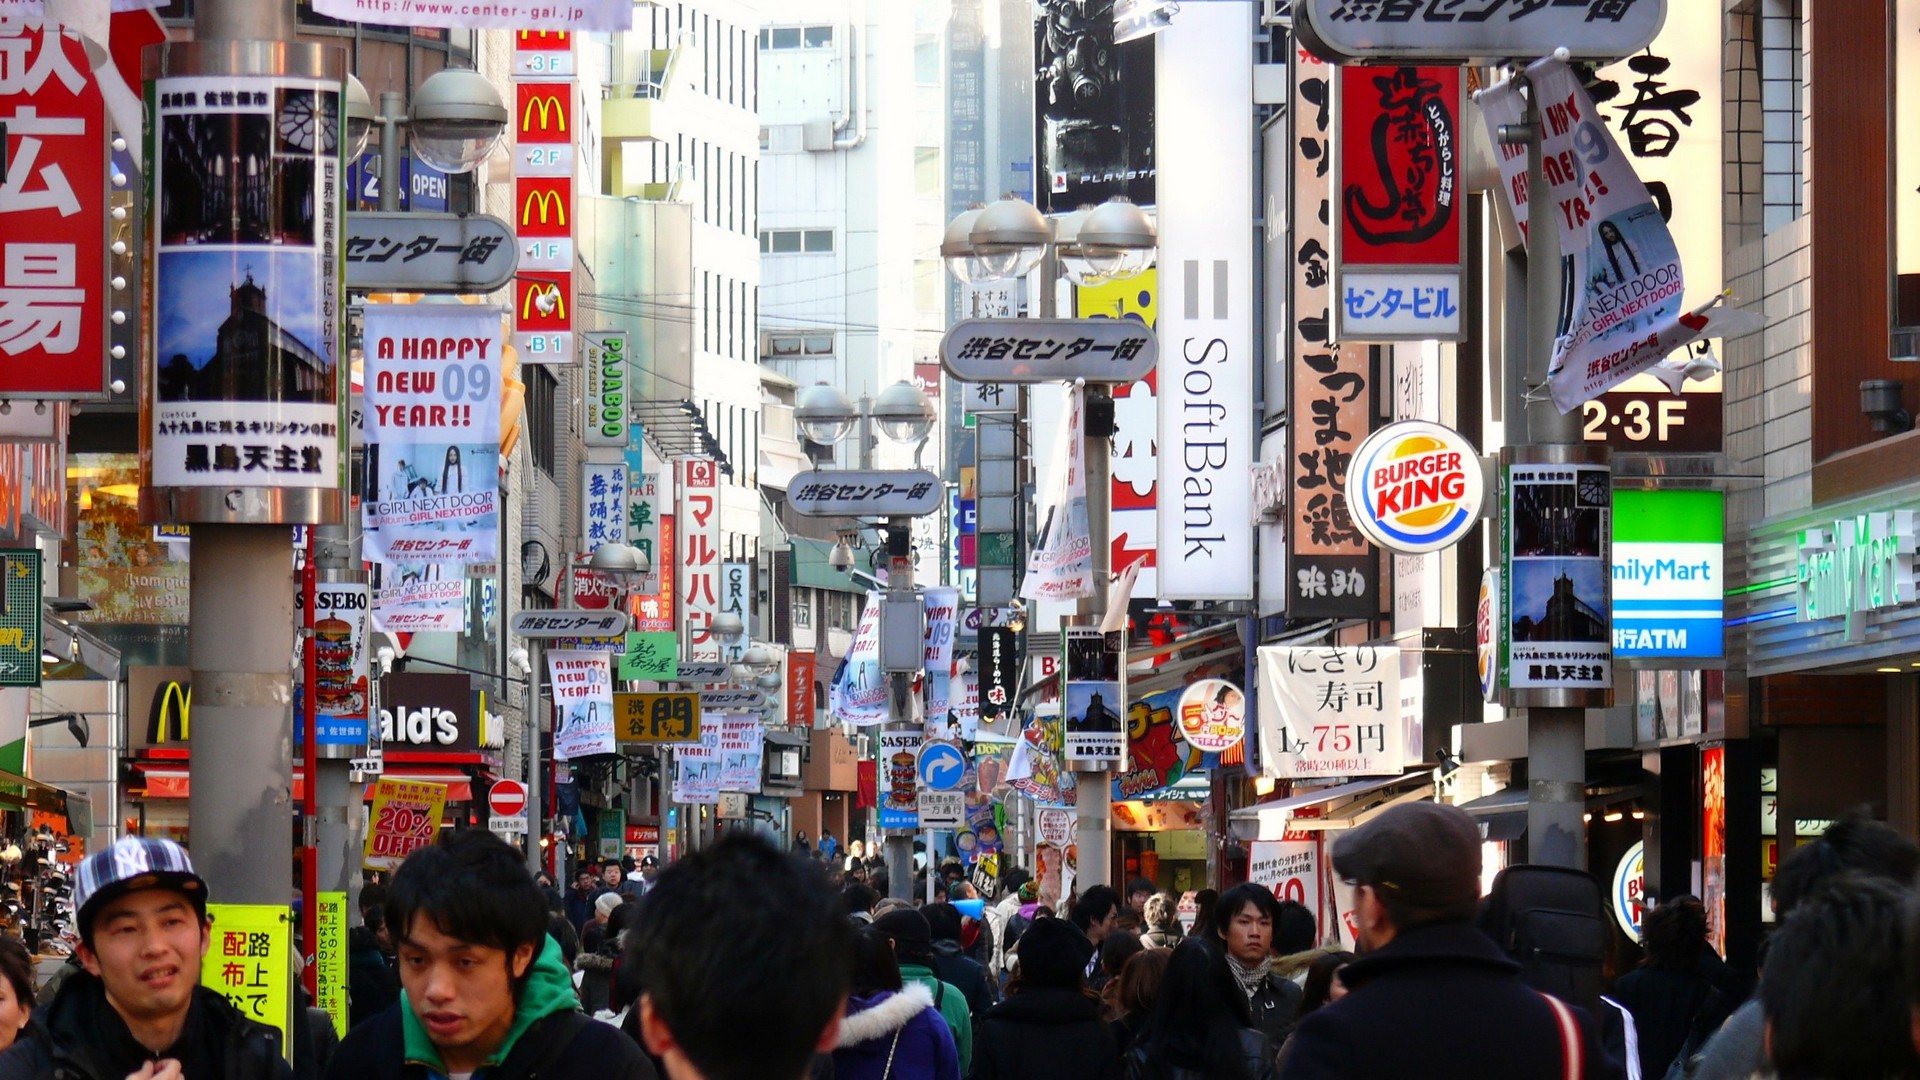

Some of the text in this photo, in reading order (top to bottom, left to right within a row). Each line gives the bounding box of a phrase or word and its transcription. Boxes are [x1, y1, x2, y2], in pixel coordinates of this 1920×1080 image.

[1427, 104, 1453, 208] とうがらし料理
[413, 174, 446, 199] OPEN
[1344, 287, 1457, 319] センタービル
[1588, 262, 1681, 319] NEXT DOOR
[1592, 280, 1682, 333] GIRL NEXT DOOR
[377, 337, 492, 360] A HAPPY
[957, 336, 1148, 361] 渋谷センター街
[376, 363, 492, 403] NEW 09
[601, 337, 623, 439] PAJABOO
[374, 404, 472, 428] YEAR!!
[184, 444, 323, 474] 黒島天主堂
[1184, 337, 1229, 561] SoftBank
[1373, 452, 1463, 491] BURGER
[378, 490, 493, 516] GIRL NEXT DOOR
[796, 481, 933, 502] 渋谷センター街
[1376, 471, 1466, 520] KING
[409, 511, 434, 523] GIRL
[435, 507, 463, 520] NEXT
[464, 503, 494, 516] DOOR
[588, 472, 609, 554] 舞踊教
[389, 538, 473, 552] 渋谷センター街
[430, 580, 462, 593] DOOR
[295, 592, 367, 610] SSEBO
[518, 615, 616, 630] 渋谷センター街
[566, 660, 607, 670] HAPPY
[1287, 647, 1378, 675] にぎり
[1528, 664, 1605, 681] 黒島天主堂
[557, 672, 586, 684] NEW
[1315, 680, 1384, 713] 寿司
[627, 699, 645, 736] 渋谷
[650, 695, 693, 738] 門
[1294, 758, 1372, 773] 常時20種以上
[374, 806, 434, 837] 20%
[920, 806, 962, 815] 一方通行
[246, 932, 271, 1017] 路上で
